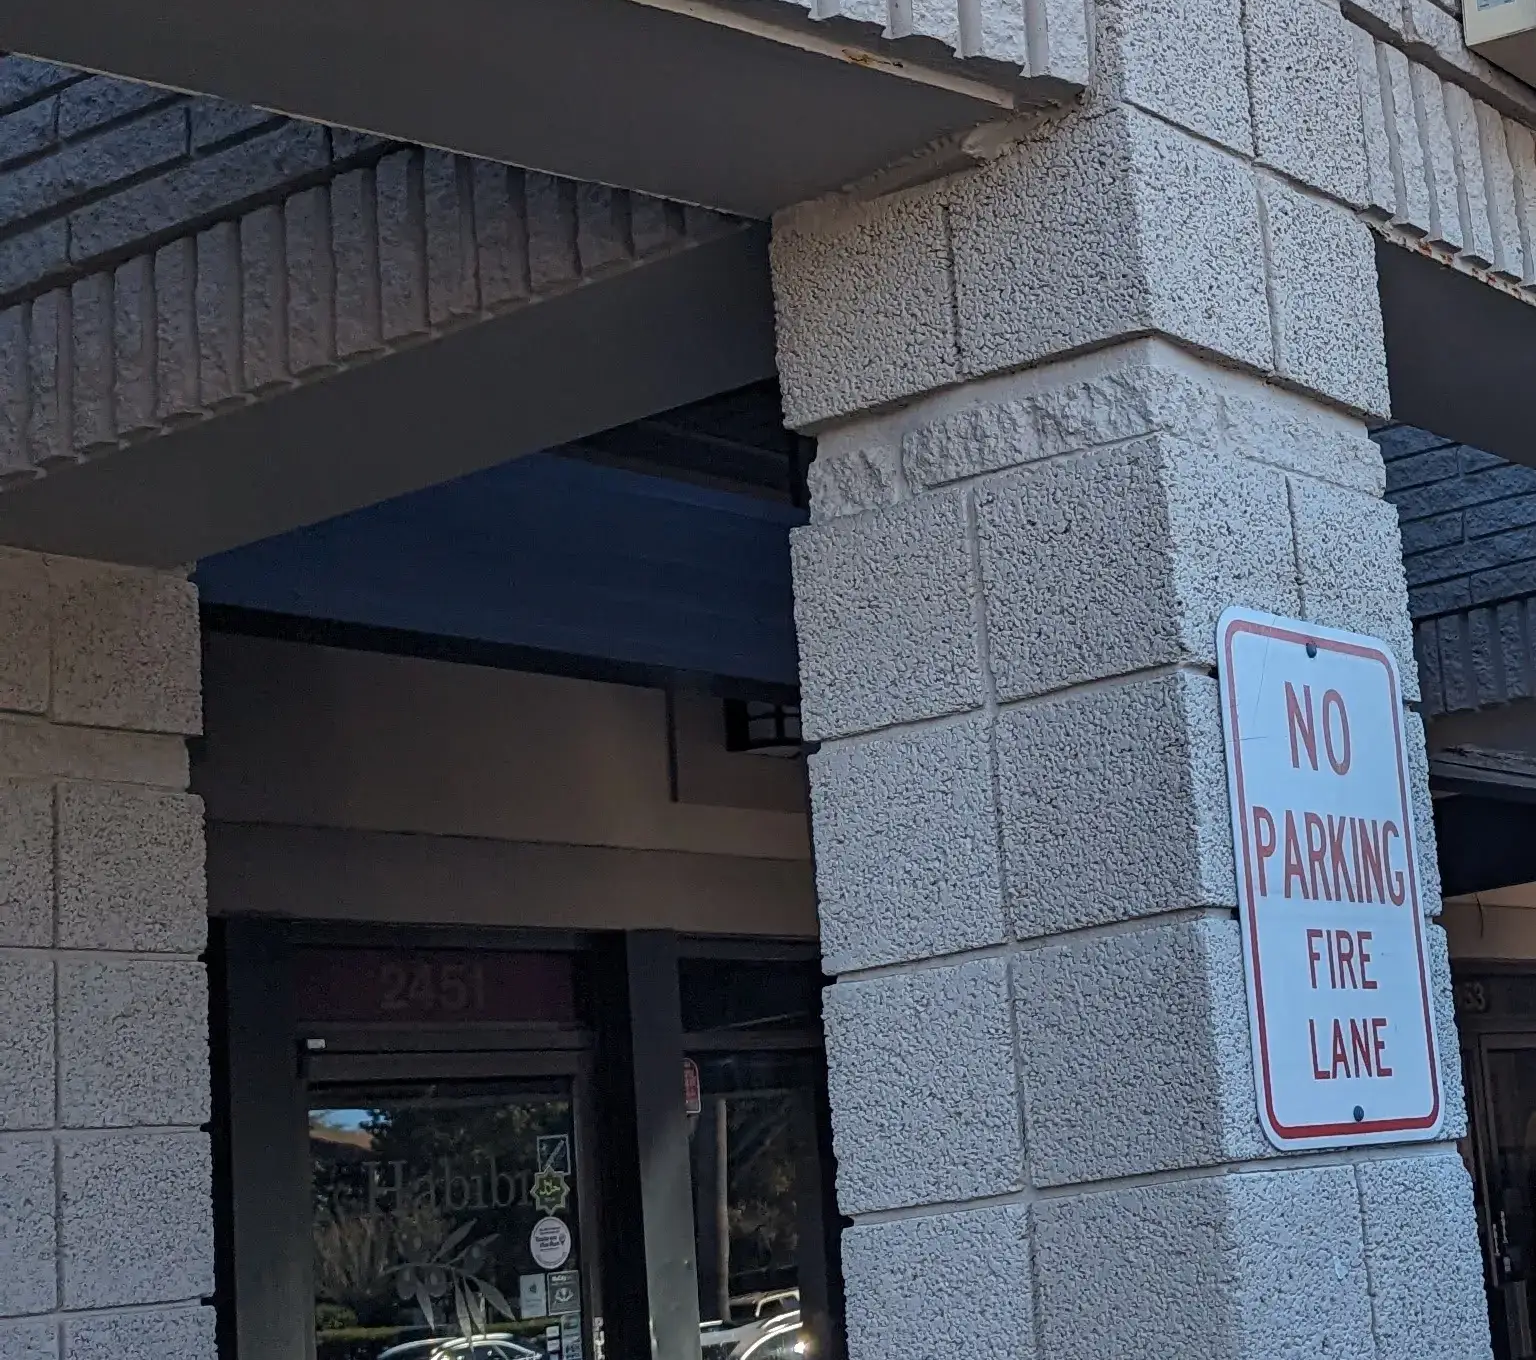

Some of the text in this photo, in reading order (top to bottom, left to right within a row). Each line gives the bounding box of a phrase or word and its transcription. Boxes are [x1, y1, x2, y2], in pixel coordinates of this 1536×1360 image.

[1284, 679, 1352, 777] NO
[1252, 804, 1407, 908] PARKING
[379, 963, 485, 1011] 2451
[1306, 928, 1379, 990] FIRE
[1308, 1017, 1394, 1081] LANE
